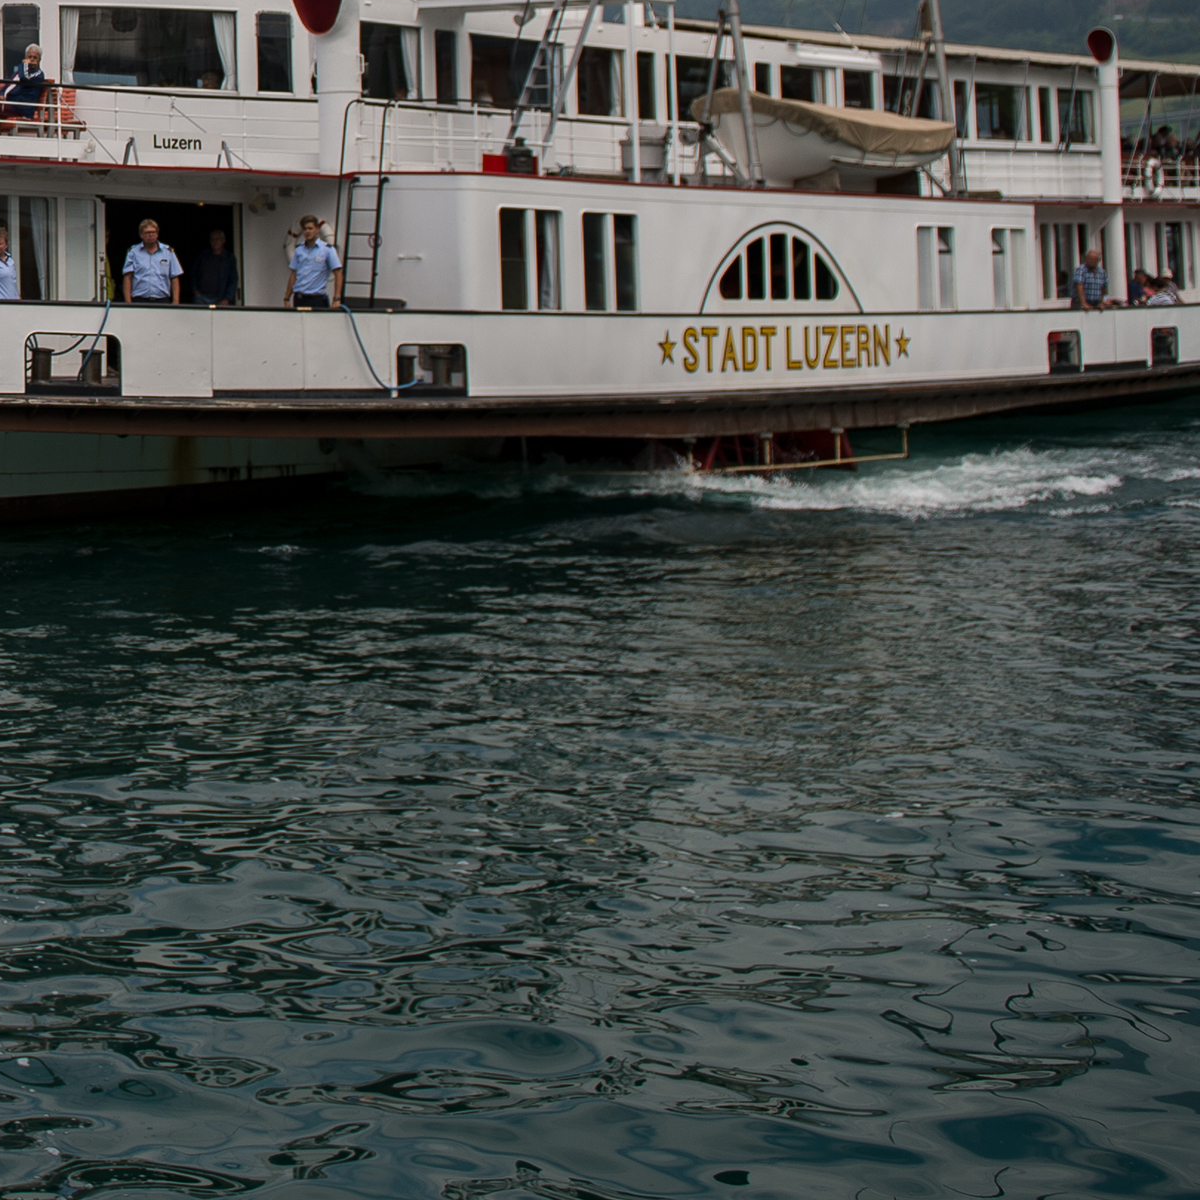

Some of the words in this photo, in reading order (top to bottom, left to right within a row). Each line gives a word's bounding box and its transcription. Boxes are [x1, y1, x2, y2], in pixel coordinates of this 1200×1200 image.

[153, 134, 202, 150] Luzern
[683, 326, 777, 372] STADT
[786, 324, 891, 370] LUZERN
